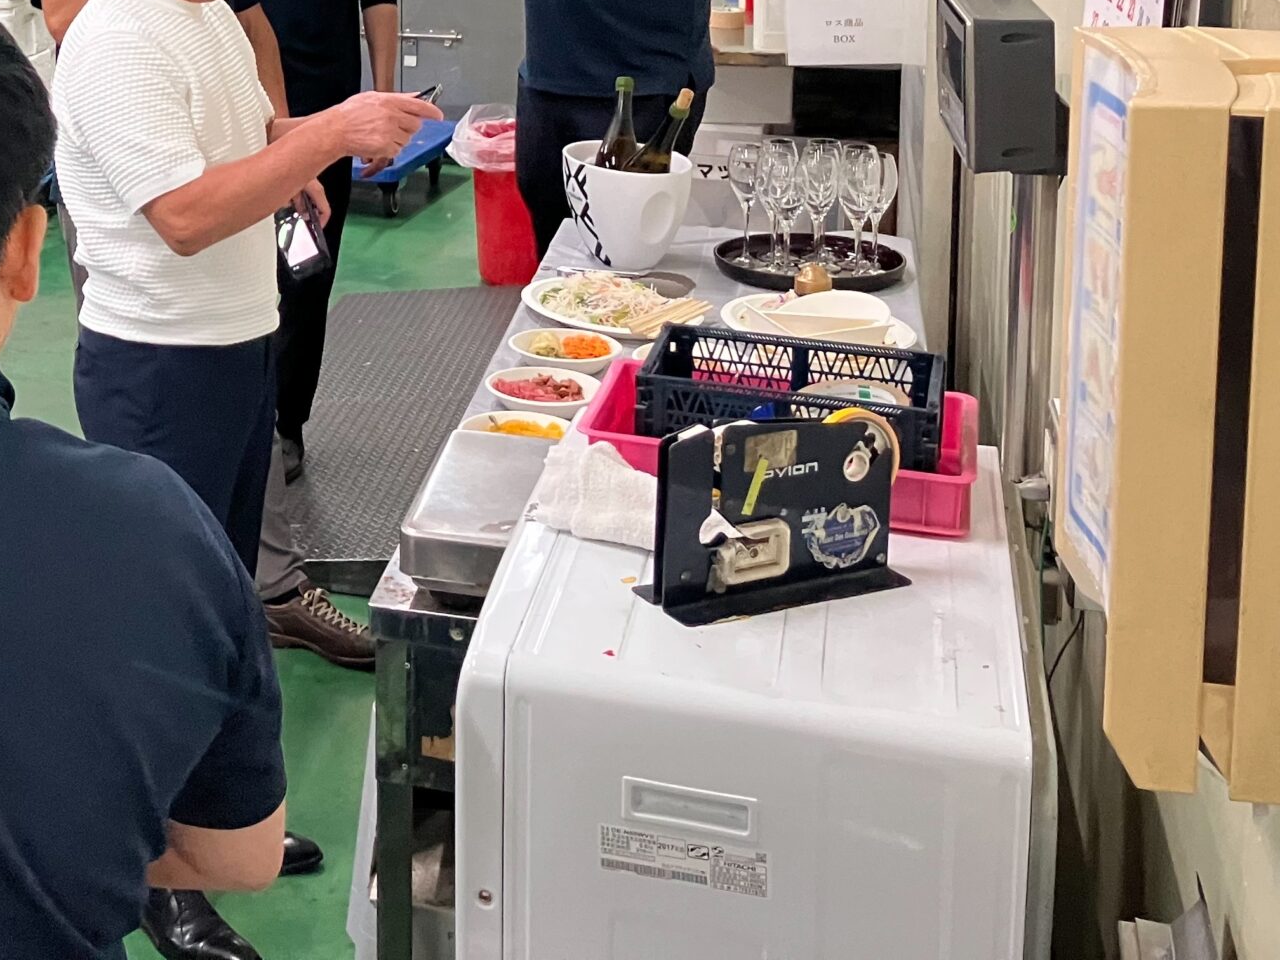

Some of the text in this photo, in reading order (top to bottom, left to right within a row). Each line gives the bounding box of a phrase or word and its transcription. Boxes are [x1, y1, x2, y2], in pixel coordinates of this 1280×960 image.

[824, 18, 864, 27] ロス商品
[833, 35, 855, 43] BOX
[724, 861, 756, 872] HITACHI
